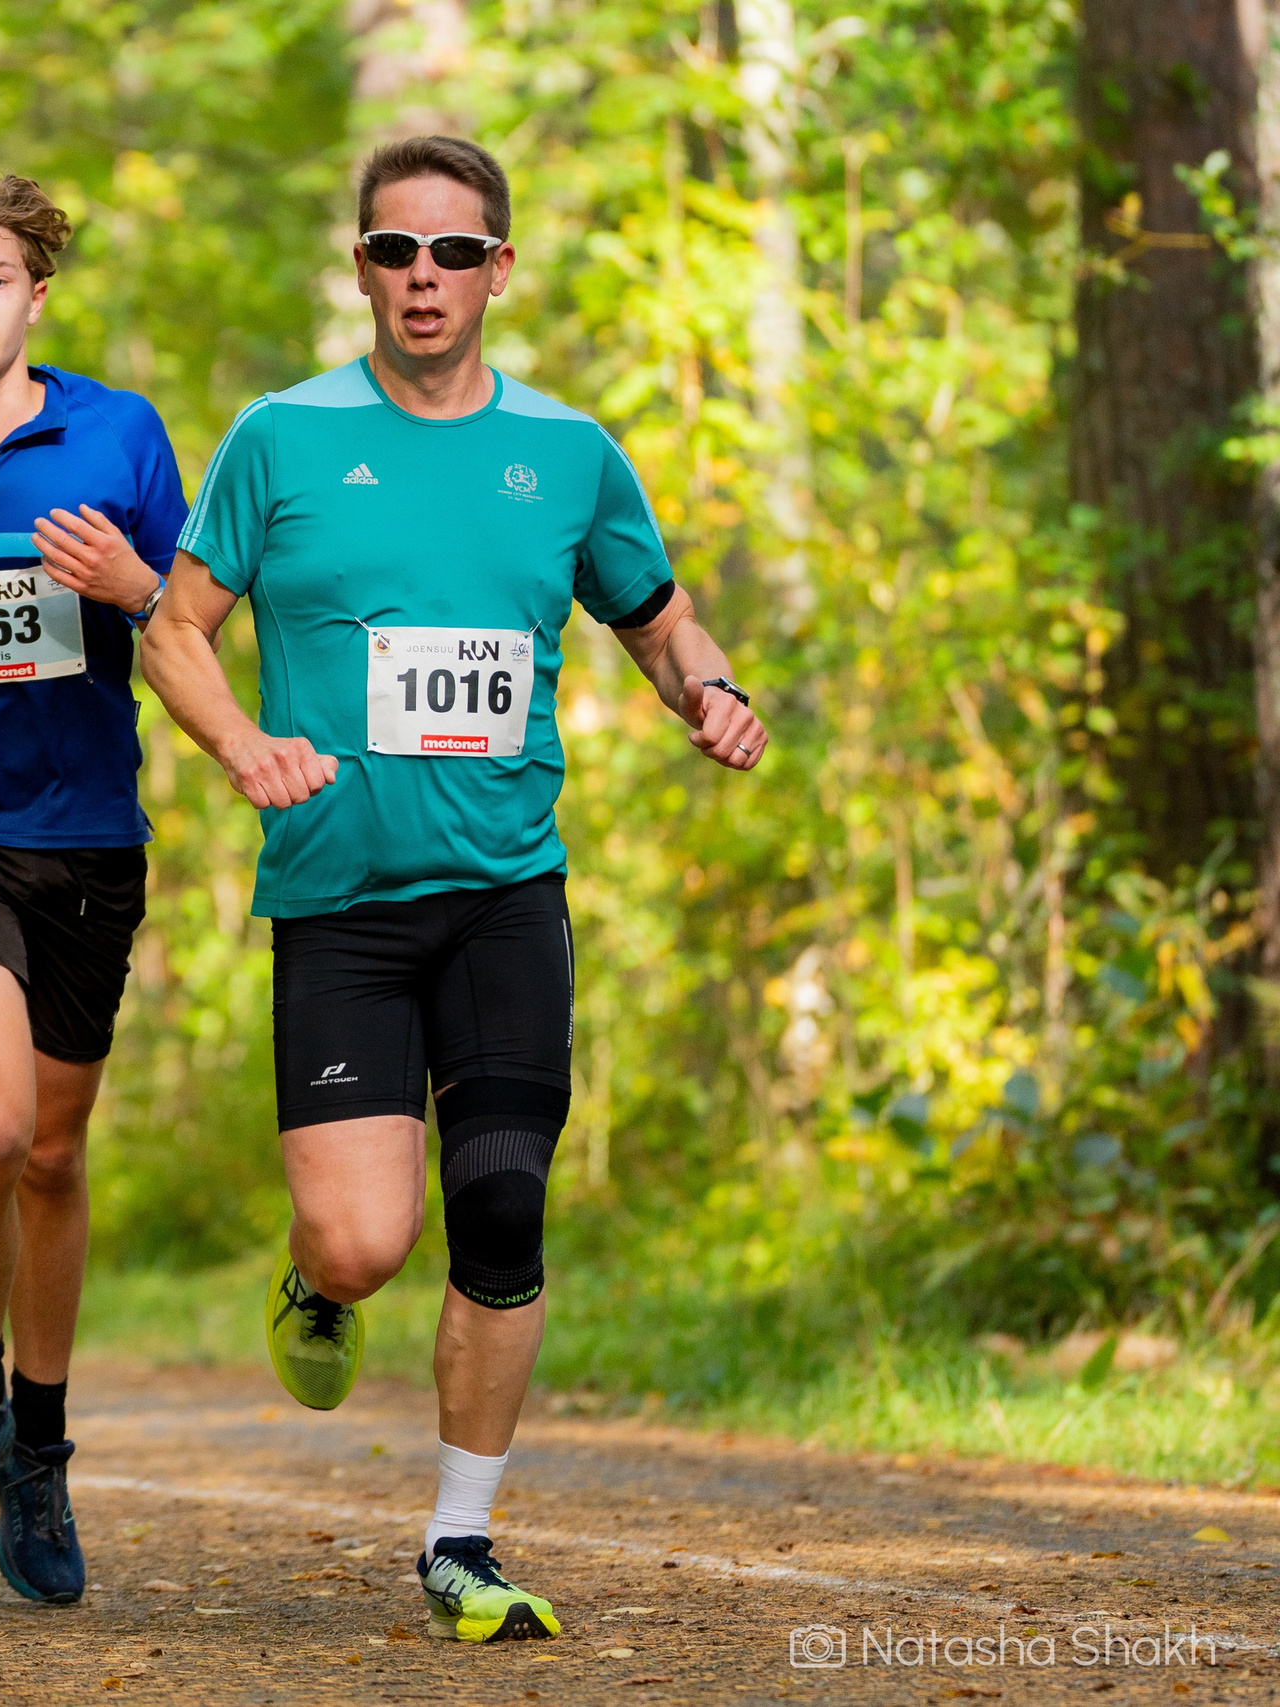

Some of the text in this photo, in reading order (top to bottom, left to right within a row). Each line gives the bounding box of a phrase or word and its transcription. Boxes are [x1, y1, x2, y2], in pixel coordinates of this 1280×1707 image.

[342, 475, 379, 485] adidas
[406, 640, 500, 661] JOENSUU RUN
[396, 668, 513, 715] 1016
[423, 737, 487, 751] motonet
[464, 1285, 540, 1305] TRITANIUM
